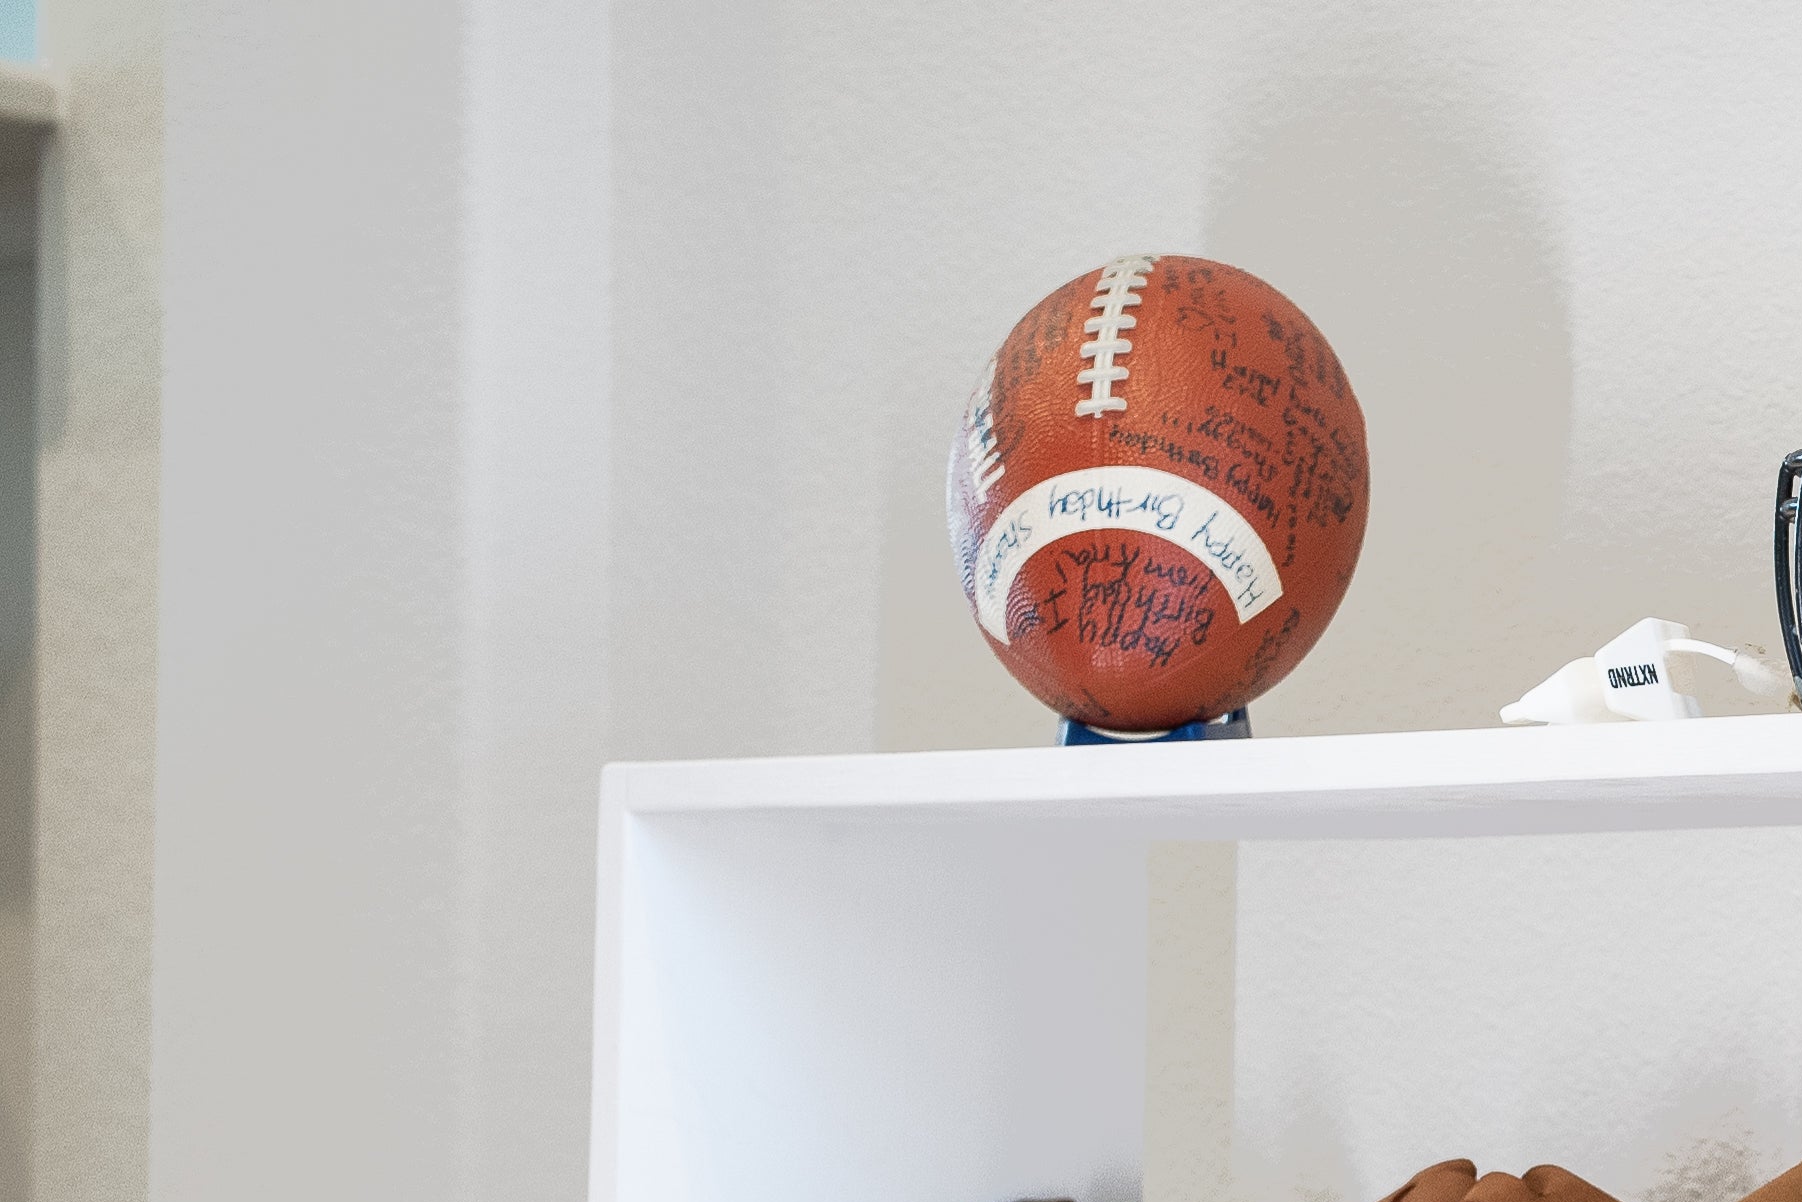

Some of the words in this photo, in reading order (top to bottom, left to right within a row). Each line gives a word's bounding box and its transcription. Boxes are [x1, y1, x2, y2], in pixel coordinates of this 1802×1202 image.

[1048, 484, 1185, 530] Birthday
[1143, 555, 1215, 601] from
[1191, 510, 1263, 608] Happy
[1078, 568, 1215, 647] Birthday
[1079, 600, 1181, 667] Happy
[1607, 663, 1659, 689] NXTRND
